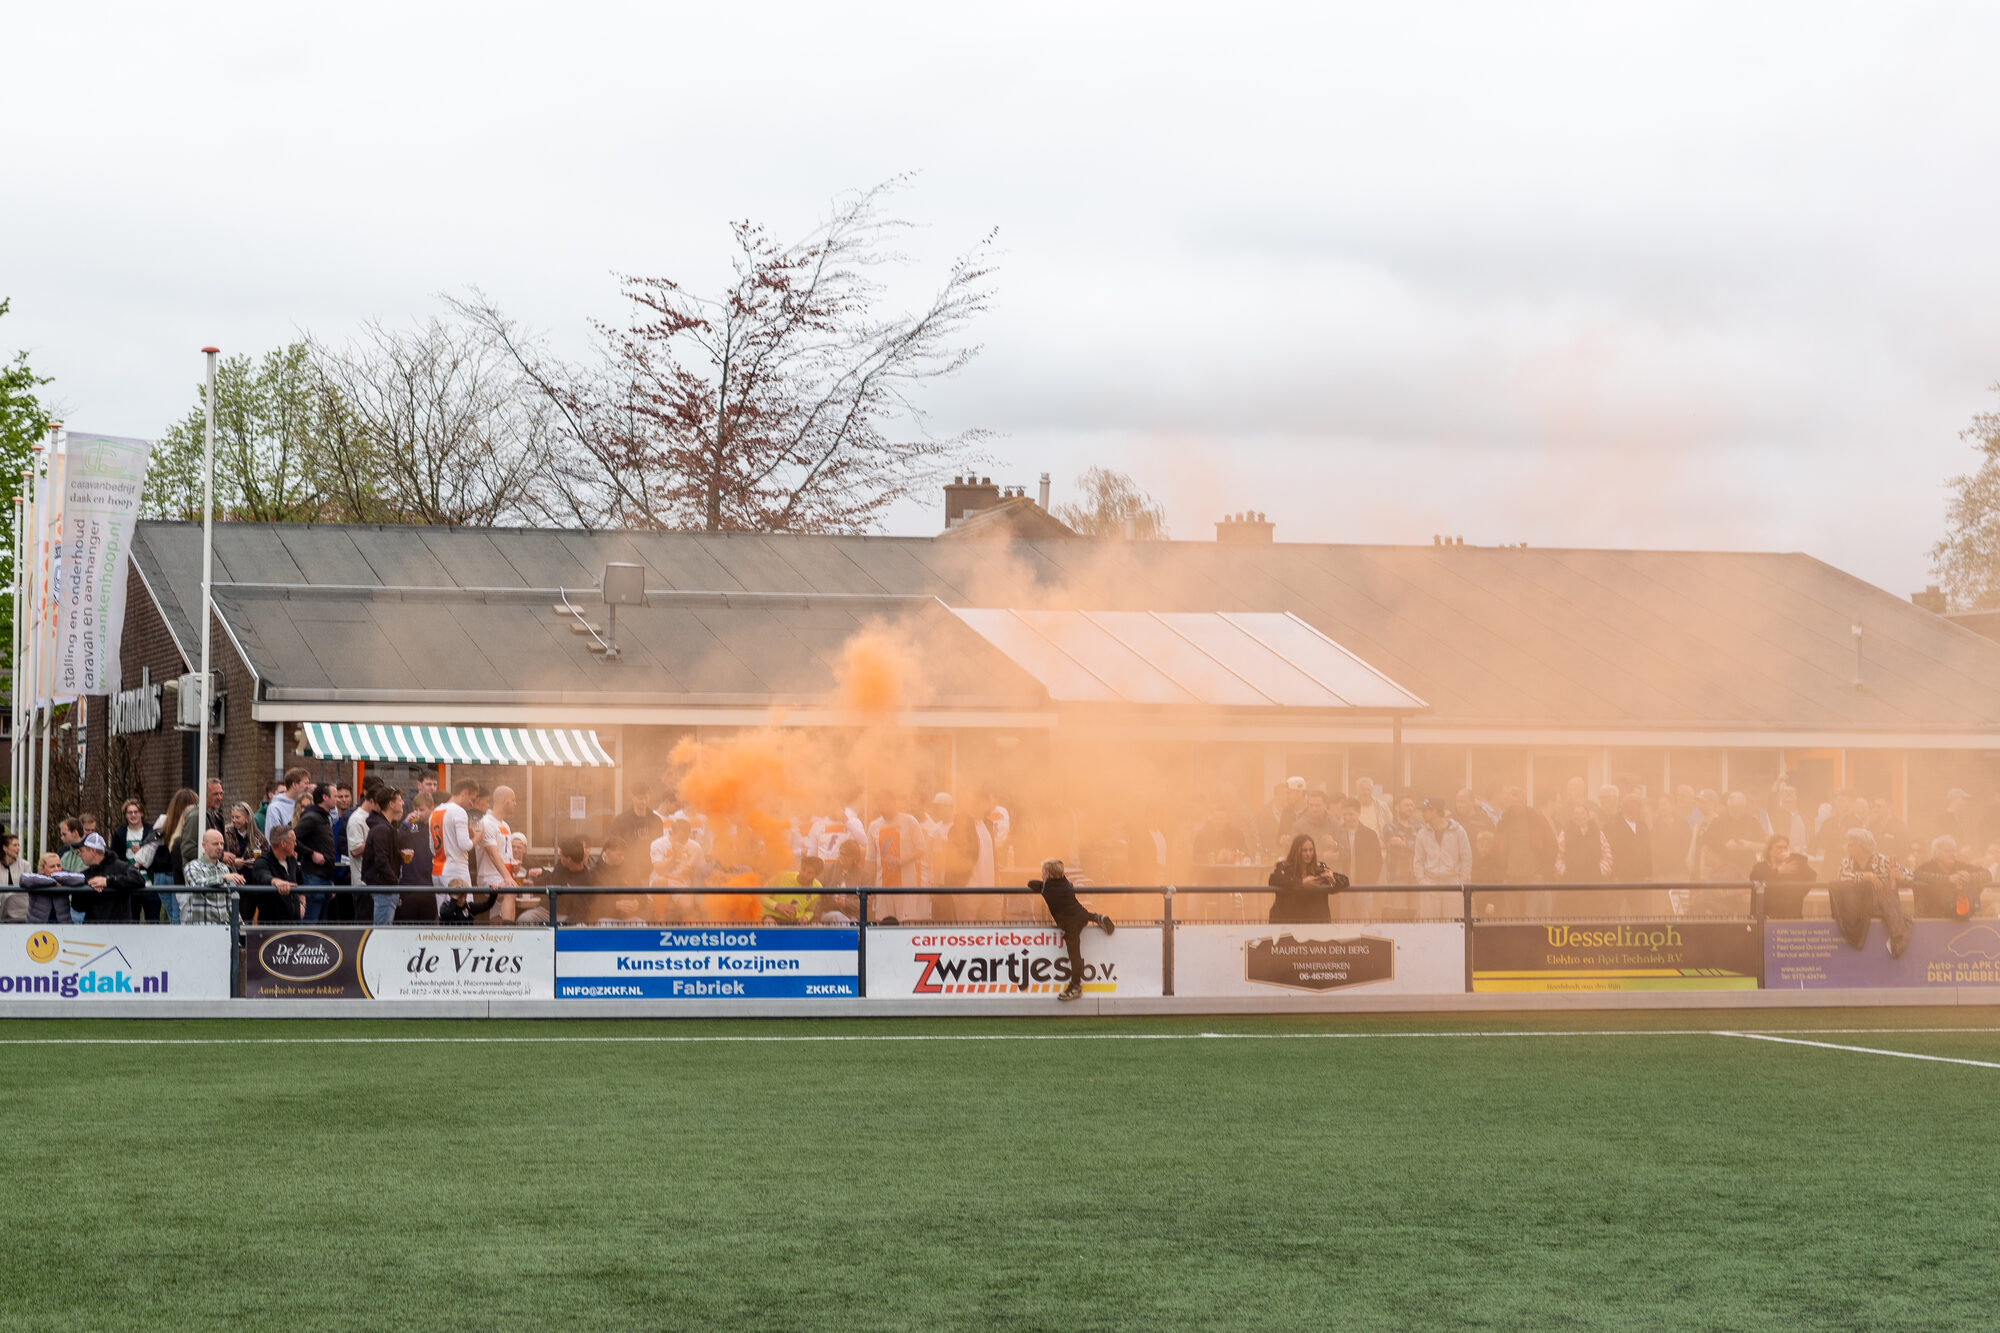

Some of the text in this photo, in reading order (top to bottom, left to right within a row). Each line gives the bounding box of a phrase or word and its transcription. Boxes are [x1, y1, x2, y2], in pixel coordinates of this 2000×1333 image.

[71, 480, 136, 495] caravanbedrijf
[93, 496, 104, 504] en
[107, 494, 133, 509] hoop
[64, 519, 85, 689] stalling en onderhoud
[84, 520, 100, 690] caravan en aanhanger
[417, 932, 514, 944] Ambachtelijke Slagerij
[660, 931, 757, 947] Zwetsloot
[911, 932, 1066, 949] carrosseriebedrij
[1546, 925, 1683, 951] Wesselingh
[277, 944, 325, 956] De Zaak
[1271, 945, 1370, 955] MAURITS VAN DEN BERG
[272, 953, 330, 965] vol Smaak
[406, 947, 523, 974] de Vries
[617, 956, 800, 973] Kunststof Kozijnen
[1293, 962, 1351, 970] TIMMERWERKEN
[913, 949, 1118, 993] Zwartjes b.v.
[1928, 971, 1952, 982] DEN
[258, 985, 296, 996] Aandacht
[673, 980, 745, 995] Fabriek
[805, 985, 852, 994] ZKKF.NL
